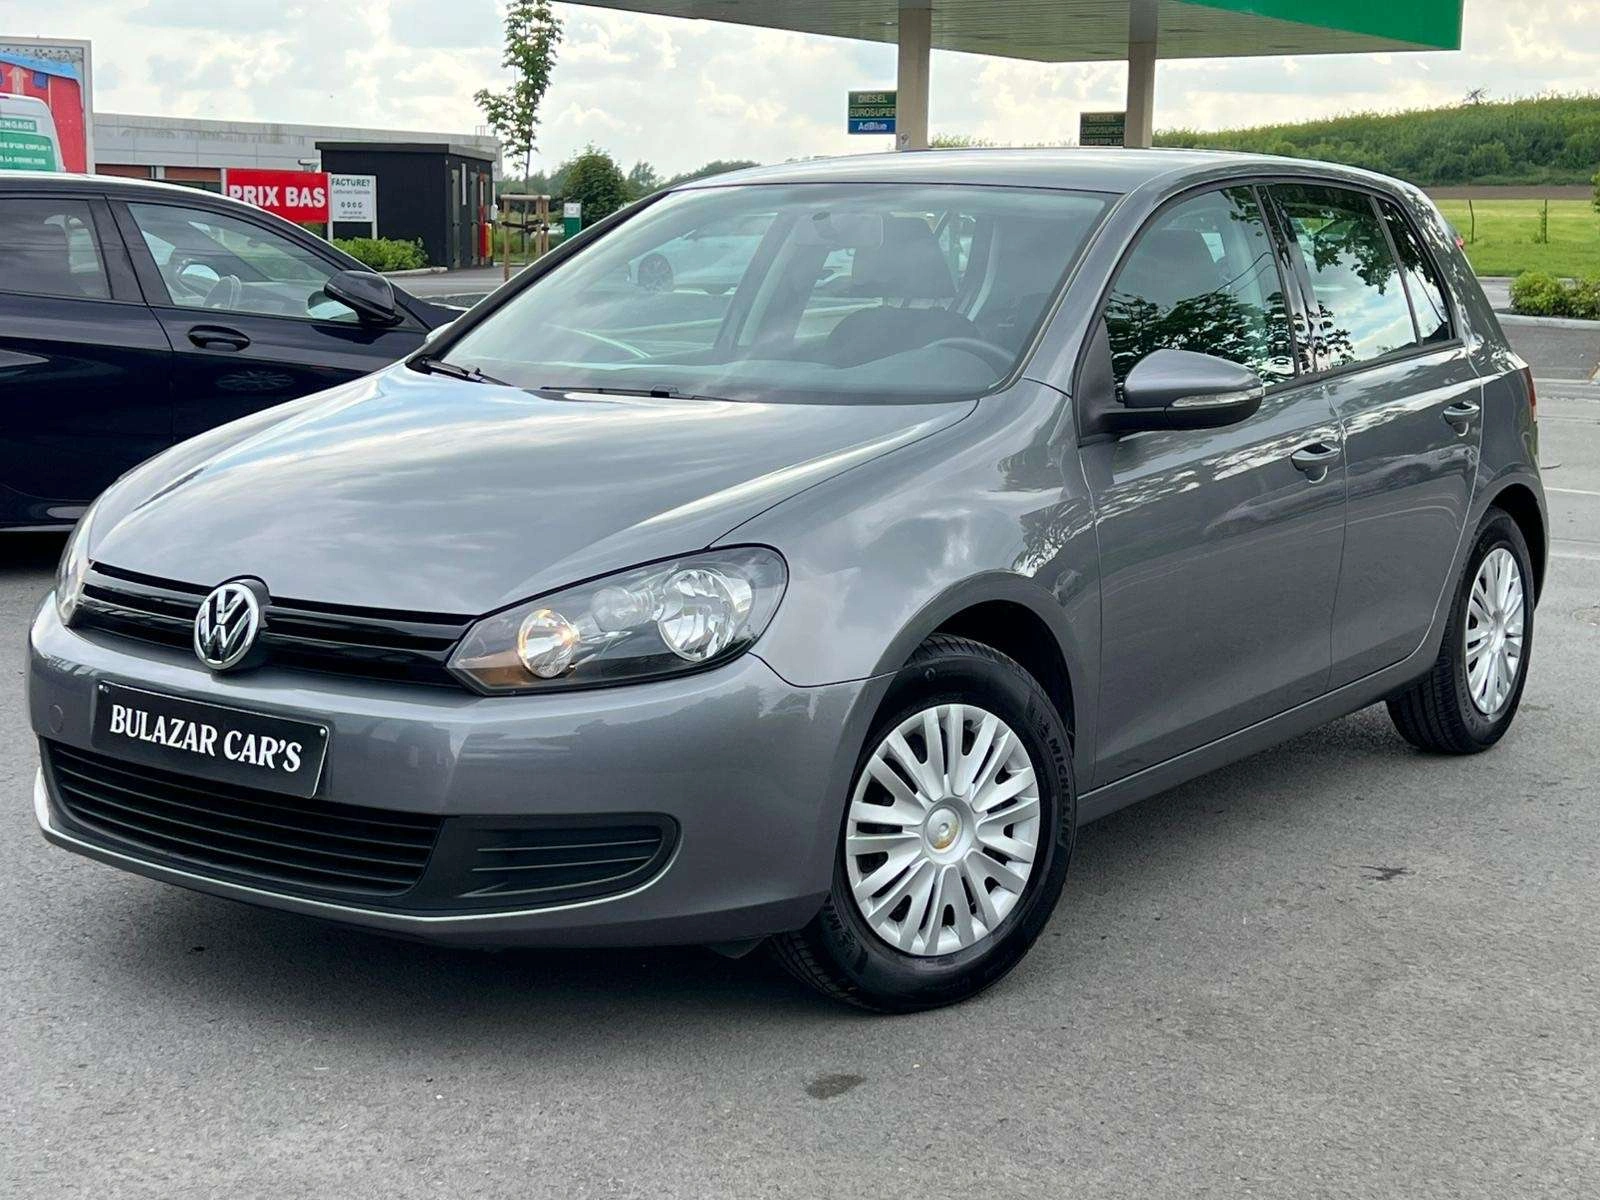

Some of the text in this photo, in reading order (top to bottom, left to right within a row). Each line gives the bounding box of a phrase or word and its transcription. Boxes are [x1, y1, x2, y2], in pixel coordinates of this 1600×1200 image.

[858, 94, 888, 103] DIESEL
[858, 121, 888, 131] AdBlue
[229, 185, 325, 208] PRIX BAS
[110, 704, 302, 773] BULAZAR CAR'S
